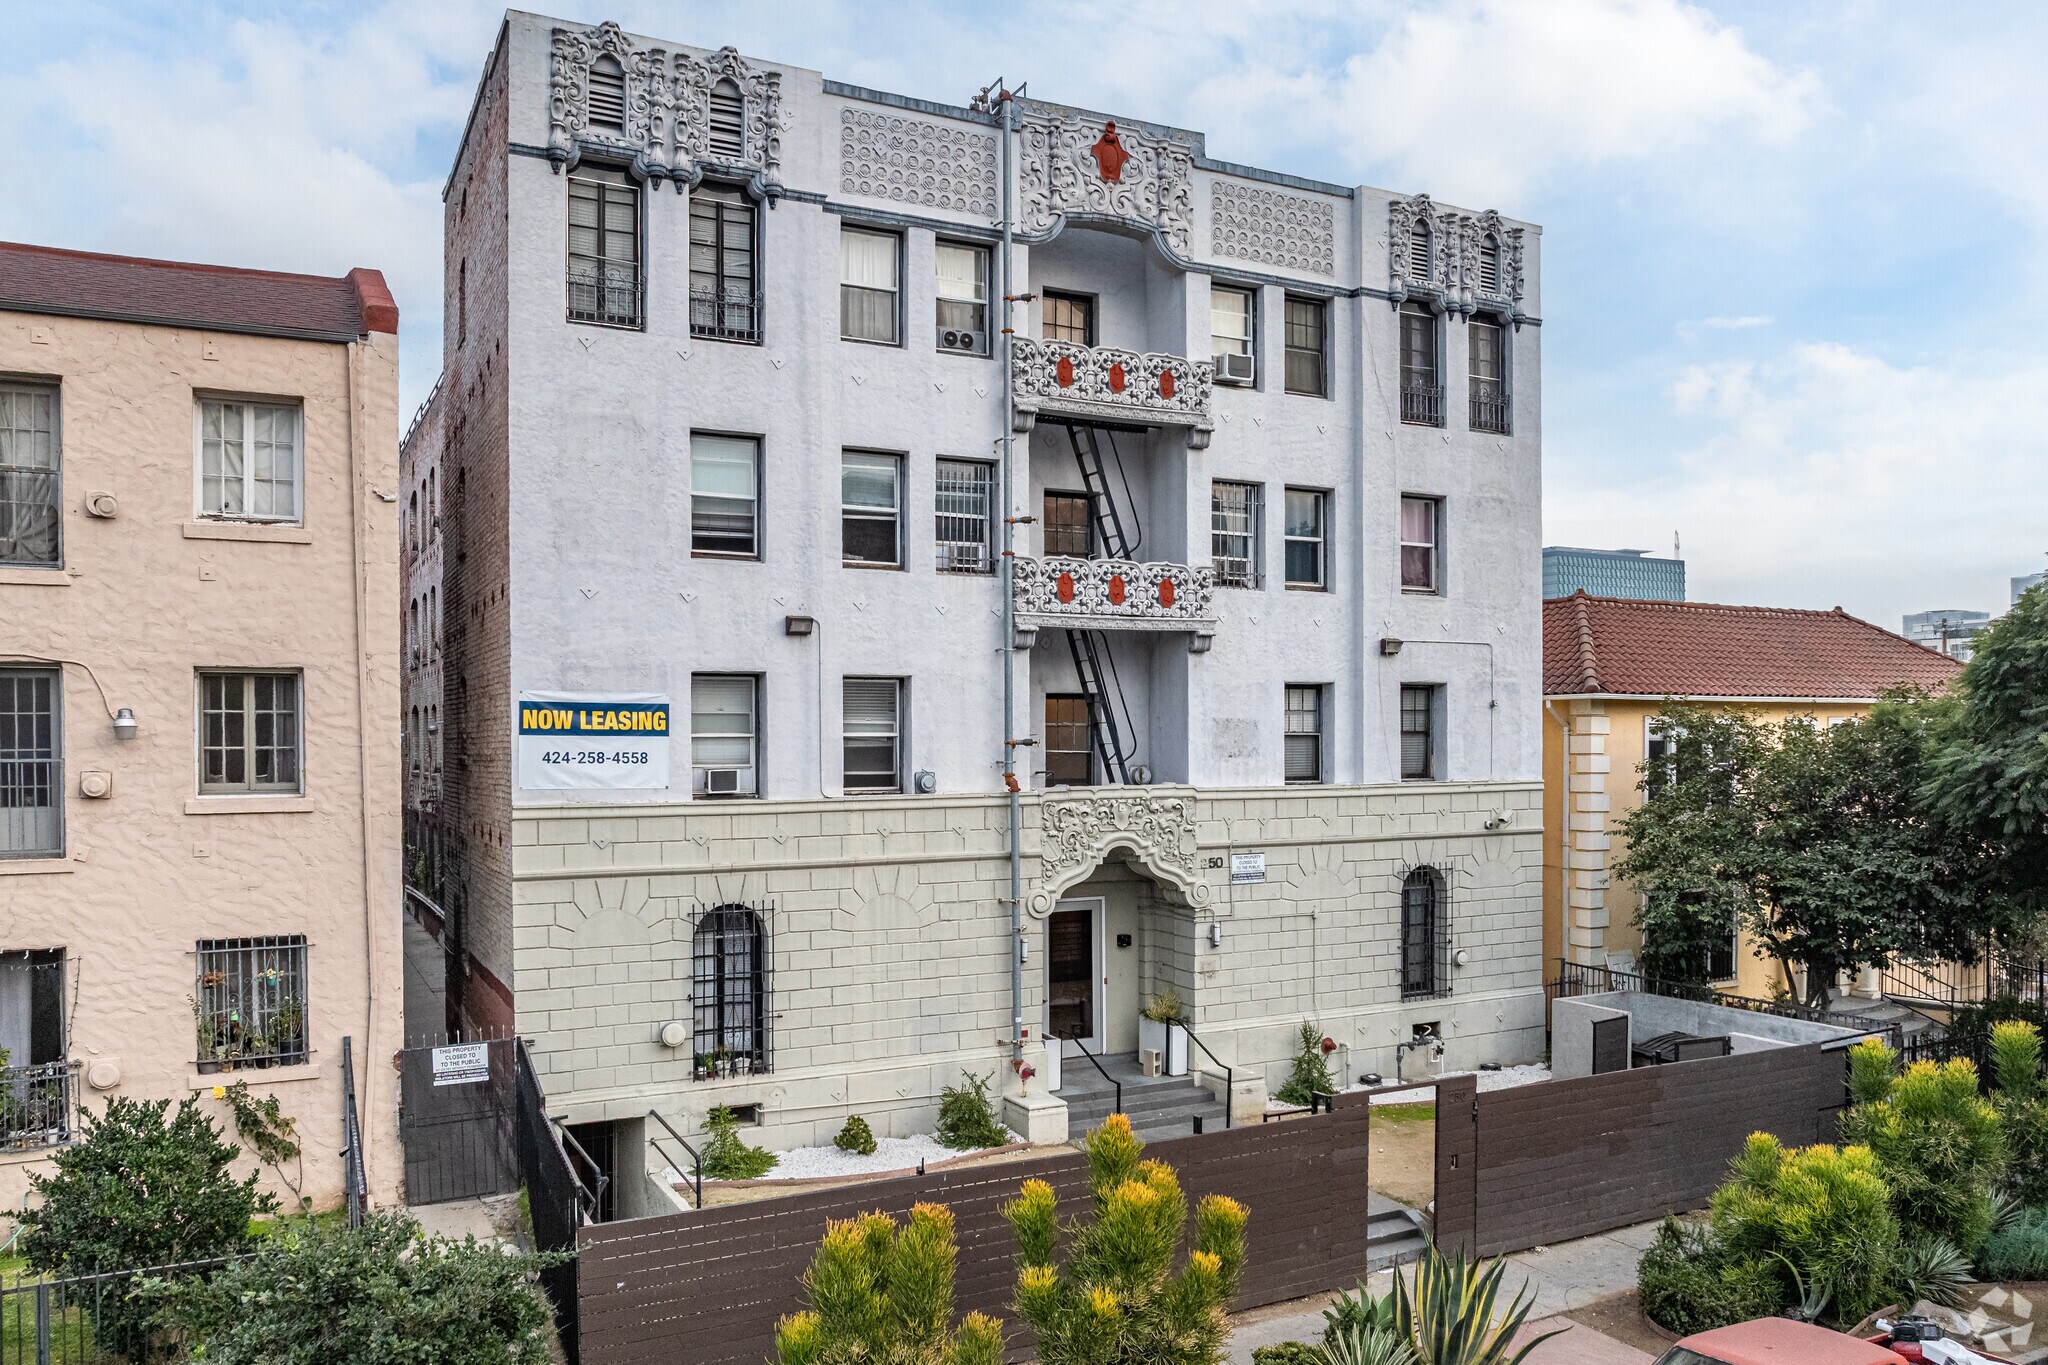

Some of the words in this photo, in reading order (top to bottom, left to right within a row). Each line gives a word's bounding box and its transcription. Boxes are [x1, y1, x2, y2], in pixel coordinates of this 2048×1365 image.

[522, 709, 573, 730] NOW
[579, 710, 667, 731] LEASING
[542, 751, 648, 764] 424-258-4558
